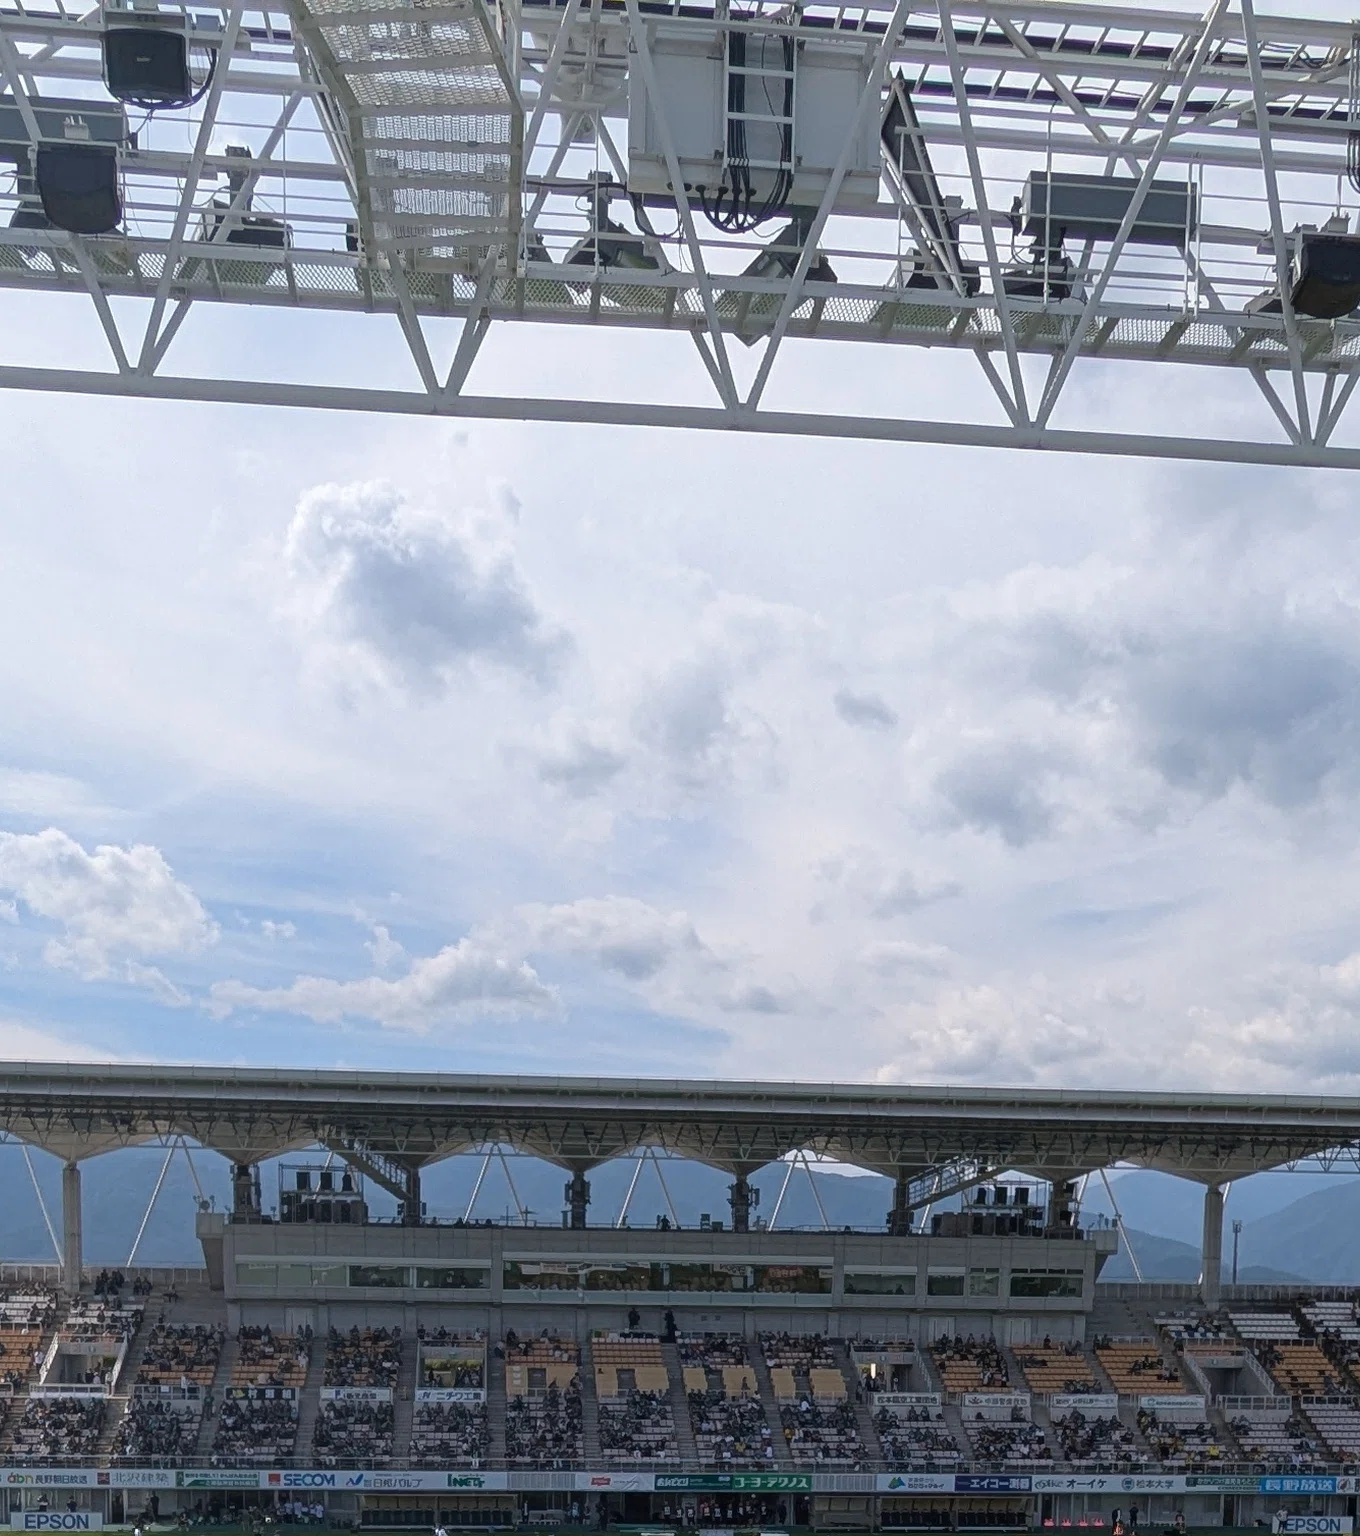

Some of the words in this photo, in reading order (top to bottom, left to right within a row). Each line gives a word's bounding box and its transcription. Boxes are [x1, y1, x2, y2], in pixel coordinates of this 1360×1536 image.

[283, 1473, 336, 1487] SECOM
[734, 1477, 809, 1489] コーヨーテクノス
[1065, 1479, 1107, 1489] オーイケ
[1135, 1479, 1174, 1489] 松本大学
[1265, 1479, 1333, 1492] 長野放送
[24, 1513, 90, 1530] EPSON
[1285, 1518, 1341, 1532] EPSON
